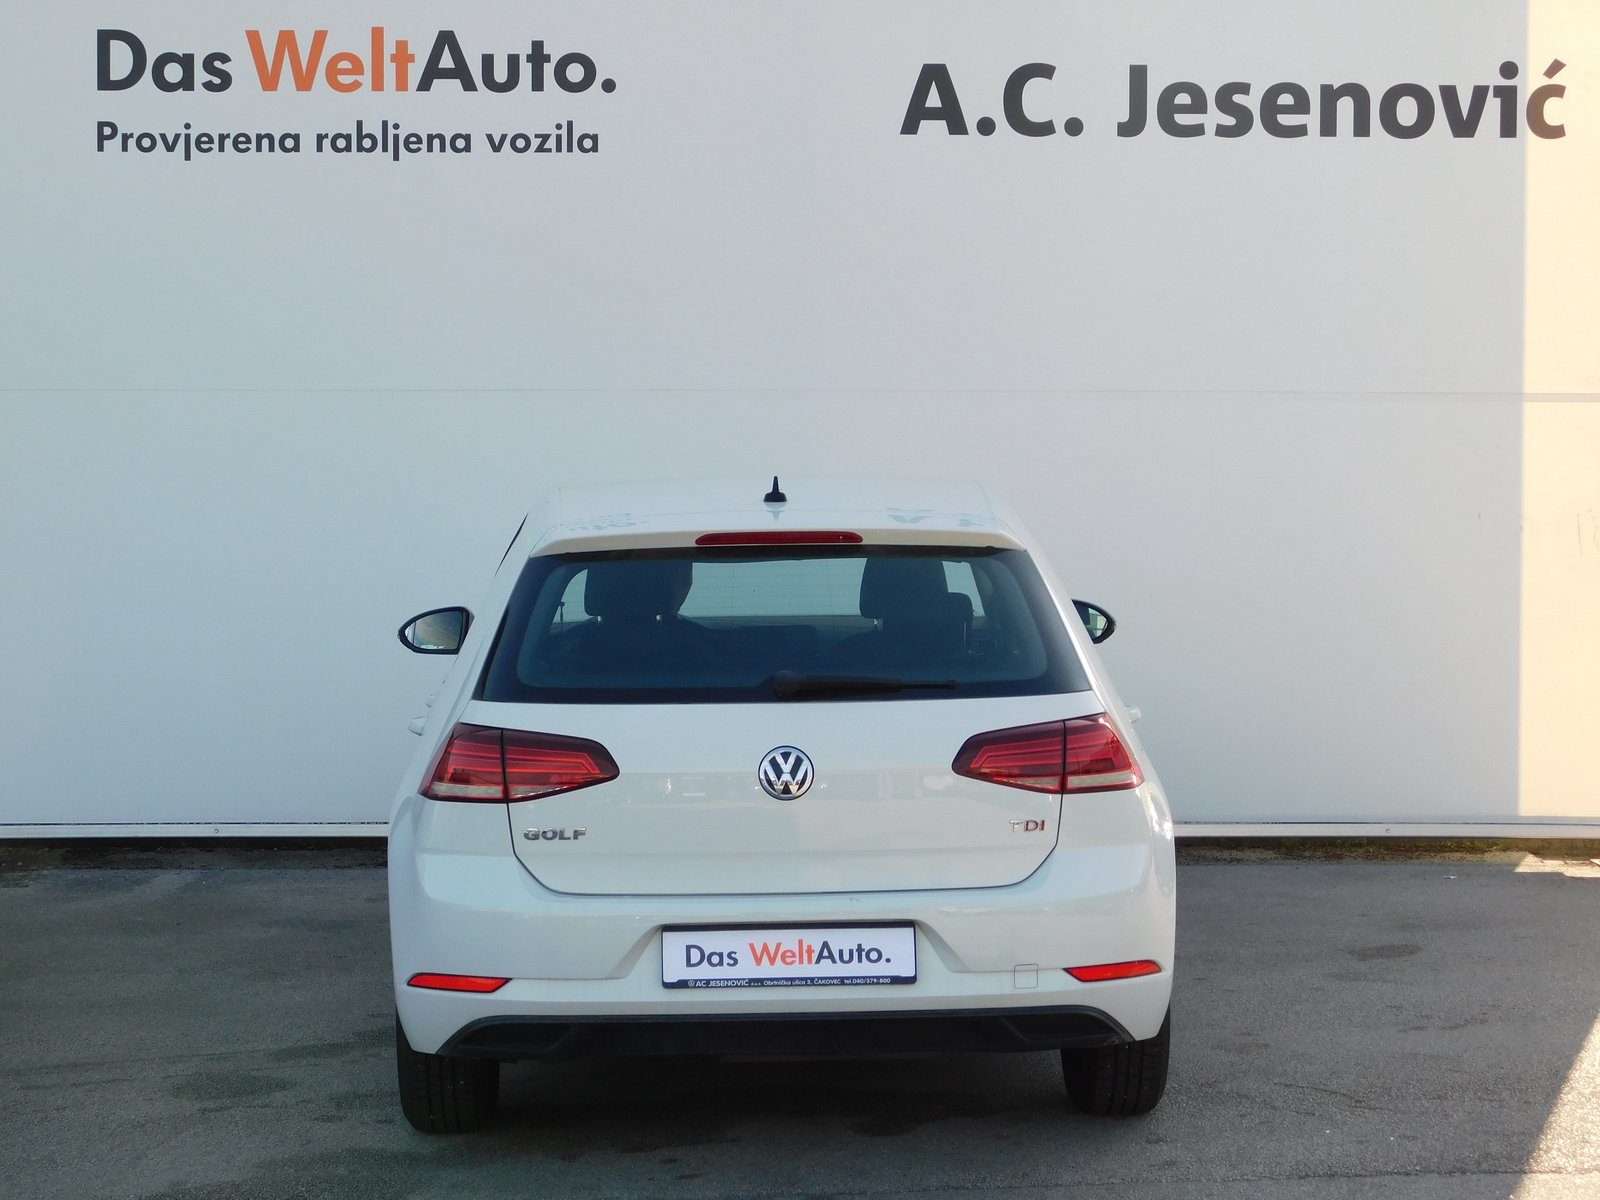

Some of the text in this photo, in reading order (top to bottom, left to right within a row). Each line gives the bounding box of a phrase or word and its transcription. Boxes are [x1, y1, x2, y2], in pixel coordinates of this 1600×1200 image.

[97, 27, 617, 94] Das WeltAuto.
[900, 58, 1567, 140] A.C. Jesenović
[97, 119, 599, 162] Provjerena rabljena vozila
[523, 827, 588, 841] GOLF
[1009, 819, 1046, 832] TDI
[685, 938, 892, 968] Das WeltAuto.
[695, 980, 707, 988] AC
[708, 978, 749, 988] JESENOVIĆ
[763, 979, 792, 987] Obrtnička
[813, 977, 841, 986] ČAKOVEC
